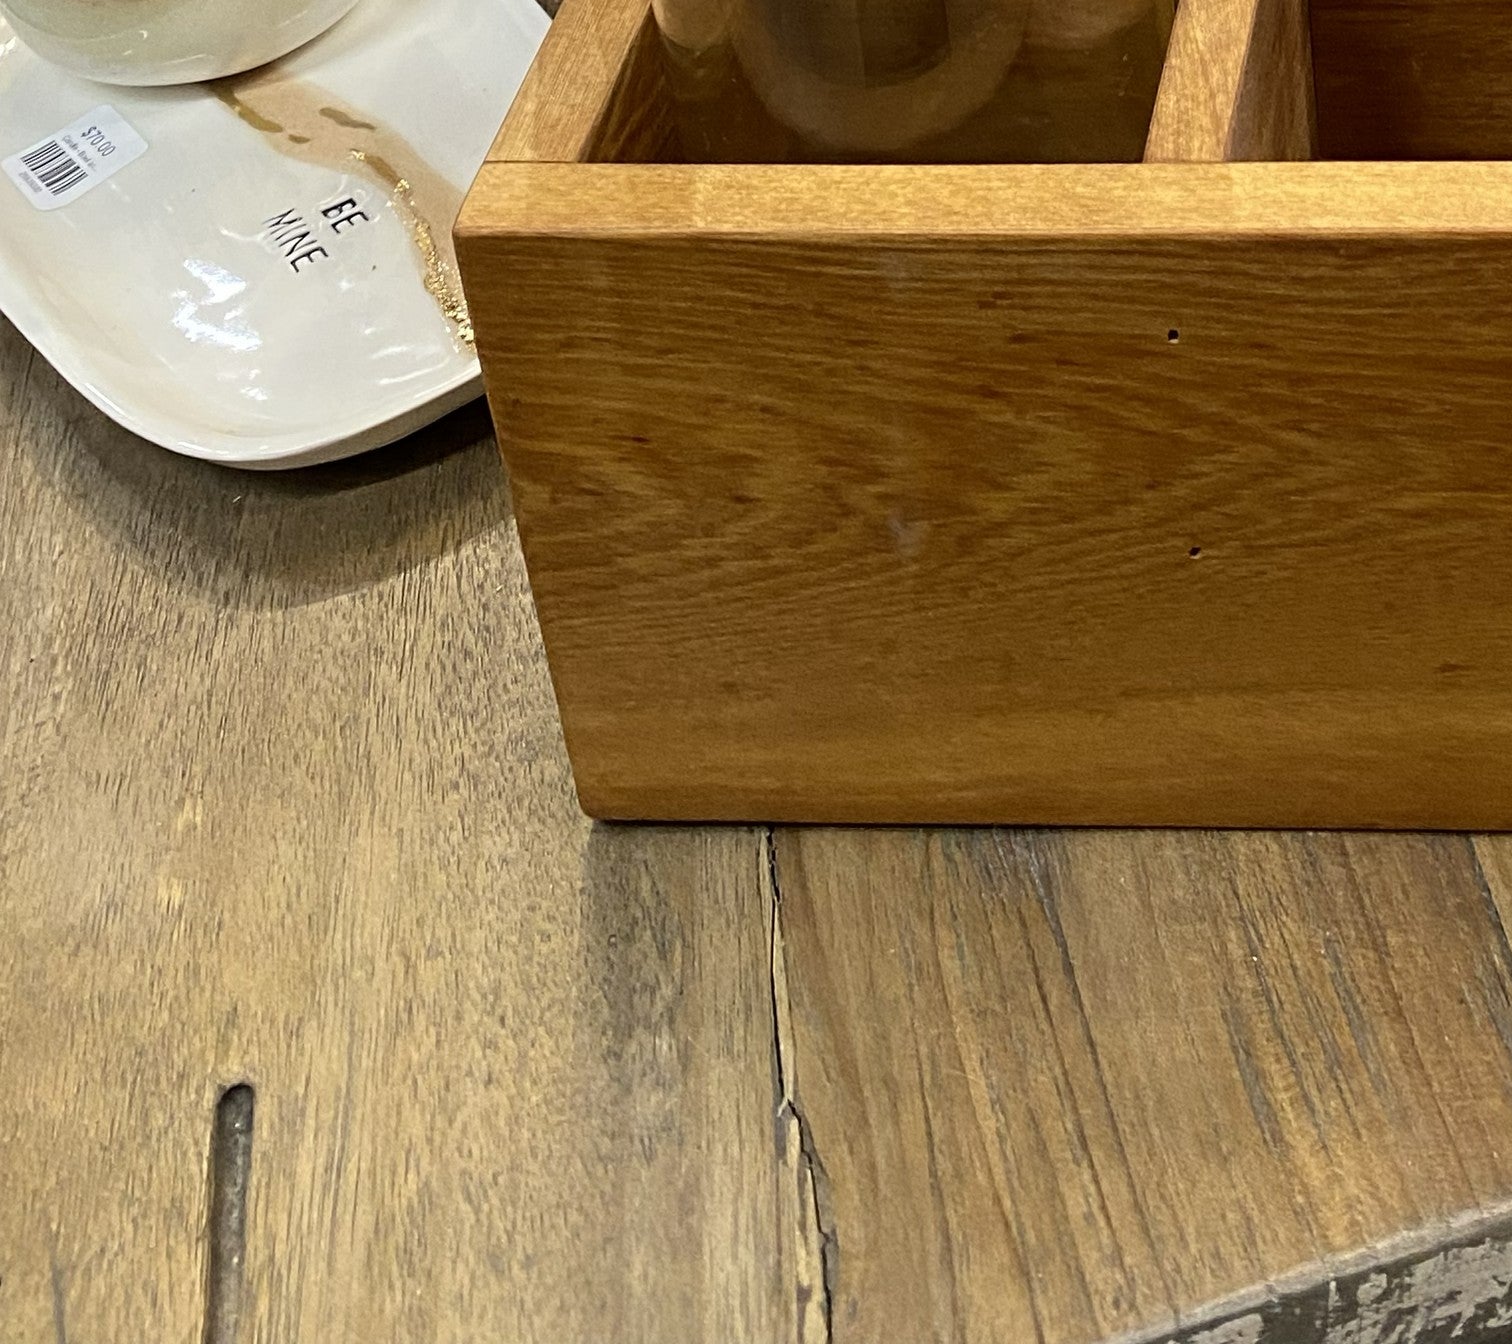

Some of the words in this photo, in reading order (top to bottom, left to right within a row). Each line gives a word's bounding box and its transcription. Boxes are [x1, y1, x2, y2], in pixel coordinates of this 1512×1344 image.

[81, 125, 116, 157] $70.00
[321, 197, 369, 234] BE
[261, 207, 329, 273] MINE
